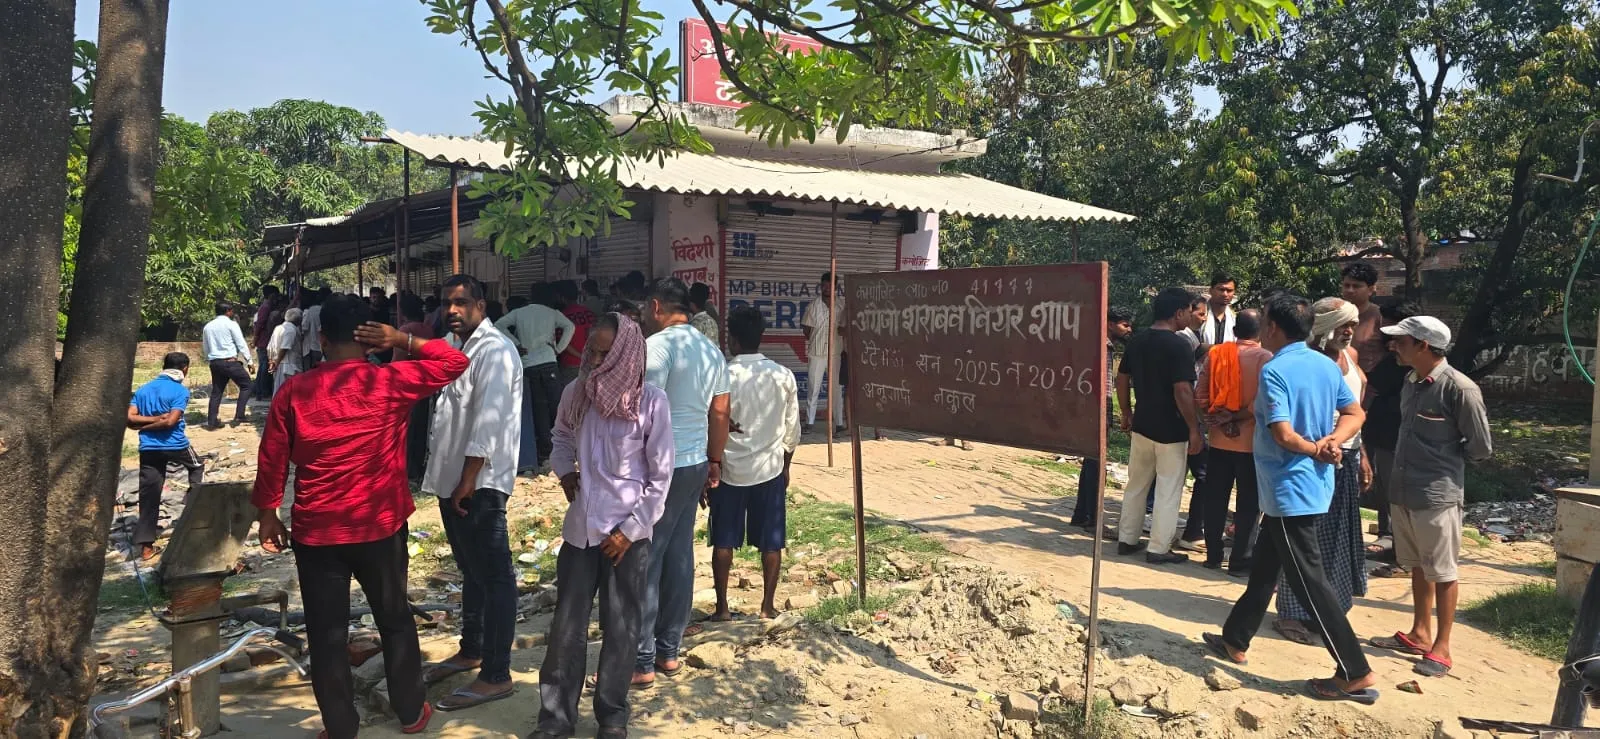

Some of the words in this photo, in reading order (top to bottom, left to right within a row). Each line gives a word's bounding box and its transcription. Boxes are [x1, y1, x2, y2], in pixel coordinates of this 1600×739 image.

[671, 235, 714, 263] विदेशी
[729, 280, 756, 296] MP
[761, 281, 810, 297] BIRLA
[954, 358, 1001, 386] 2025
